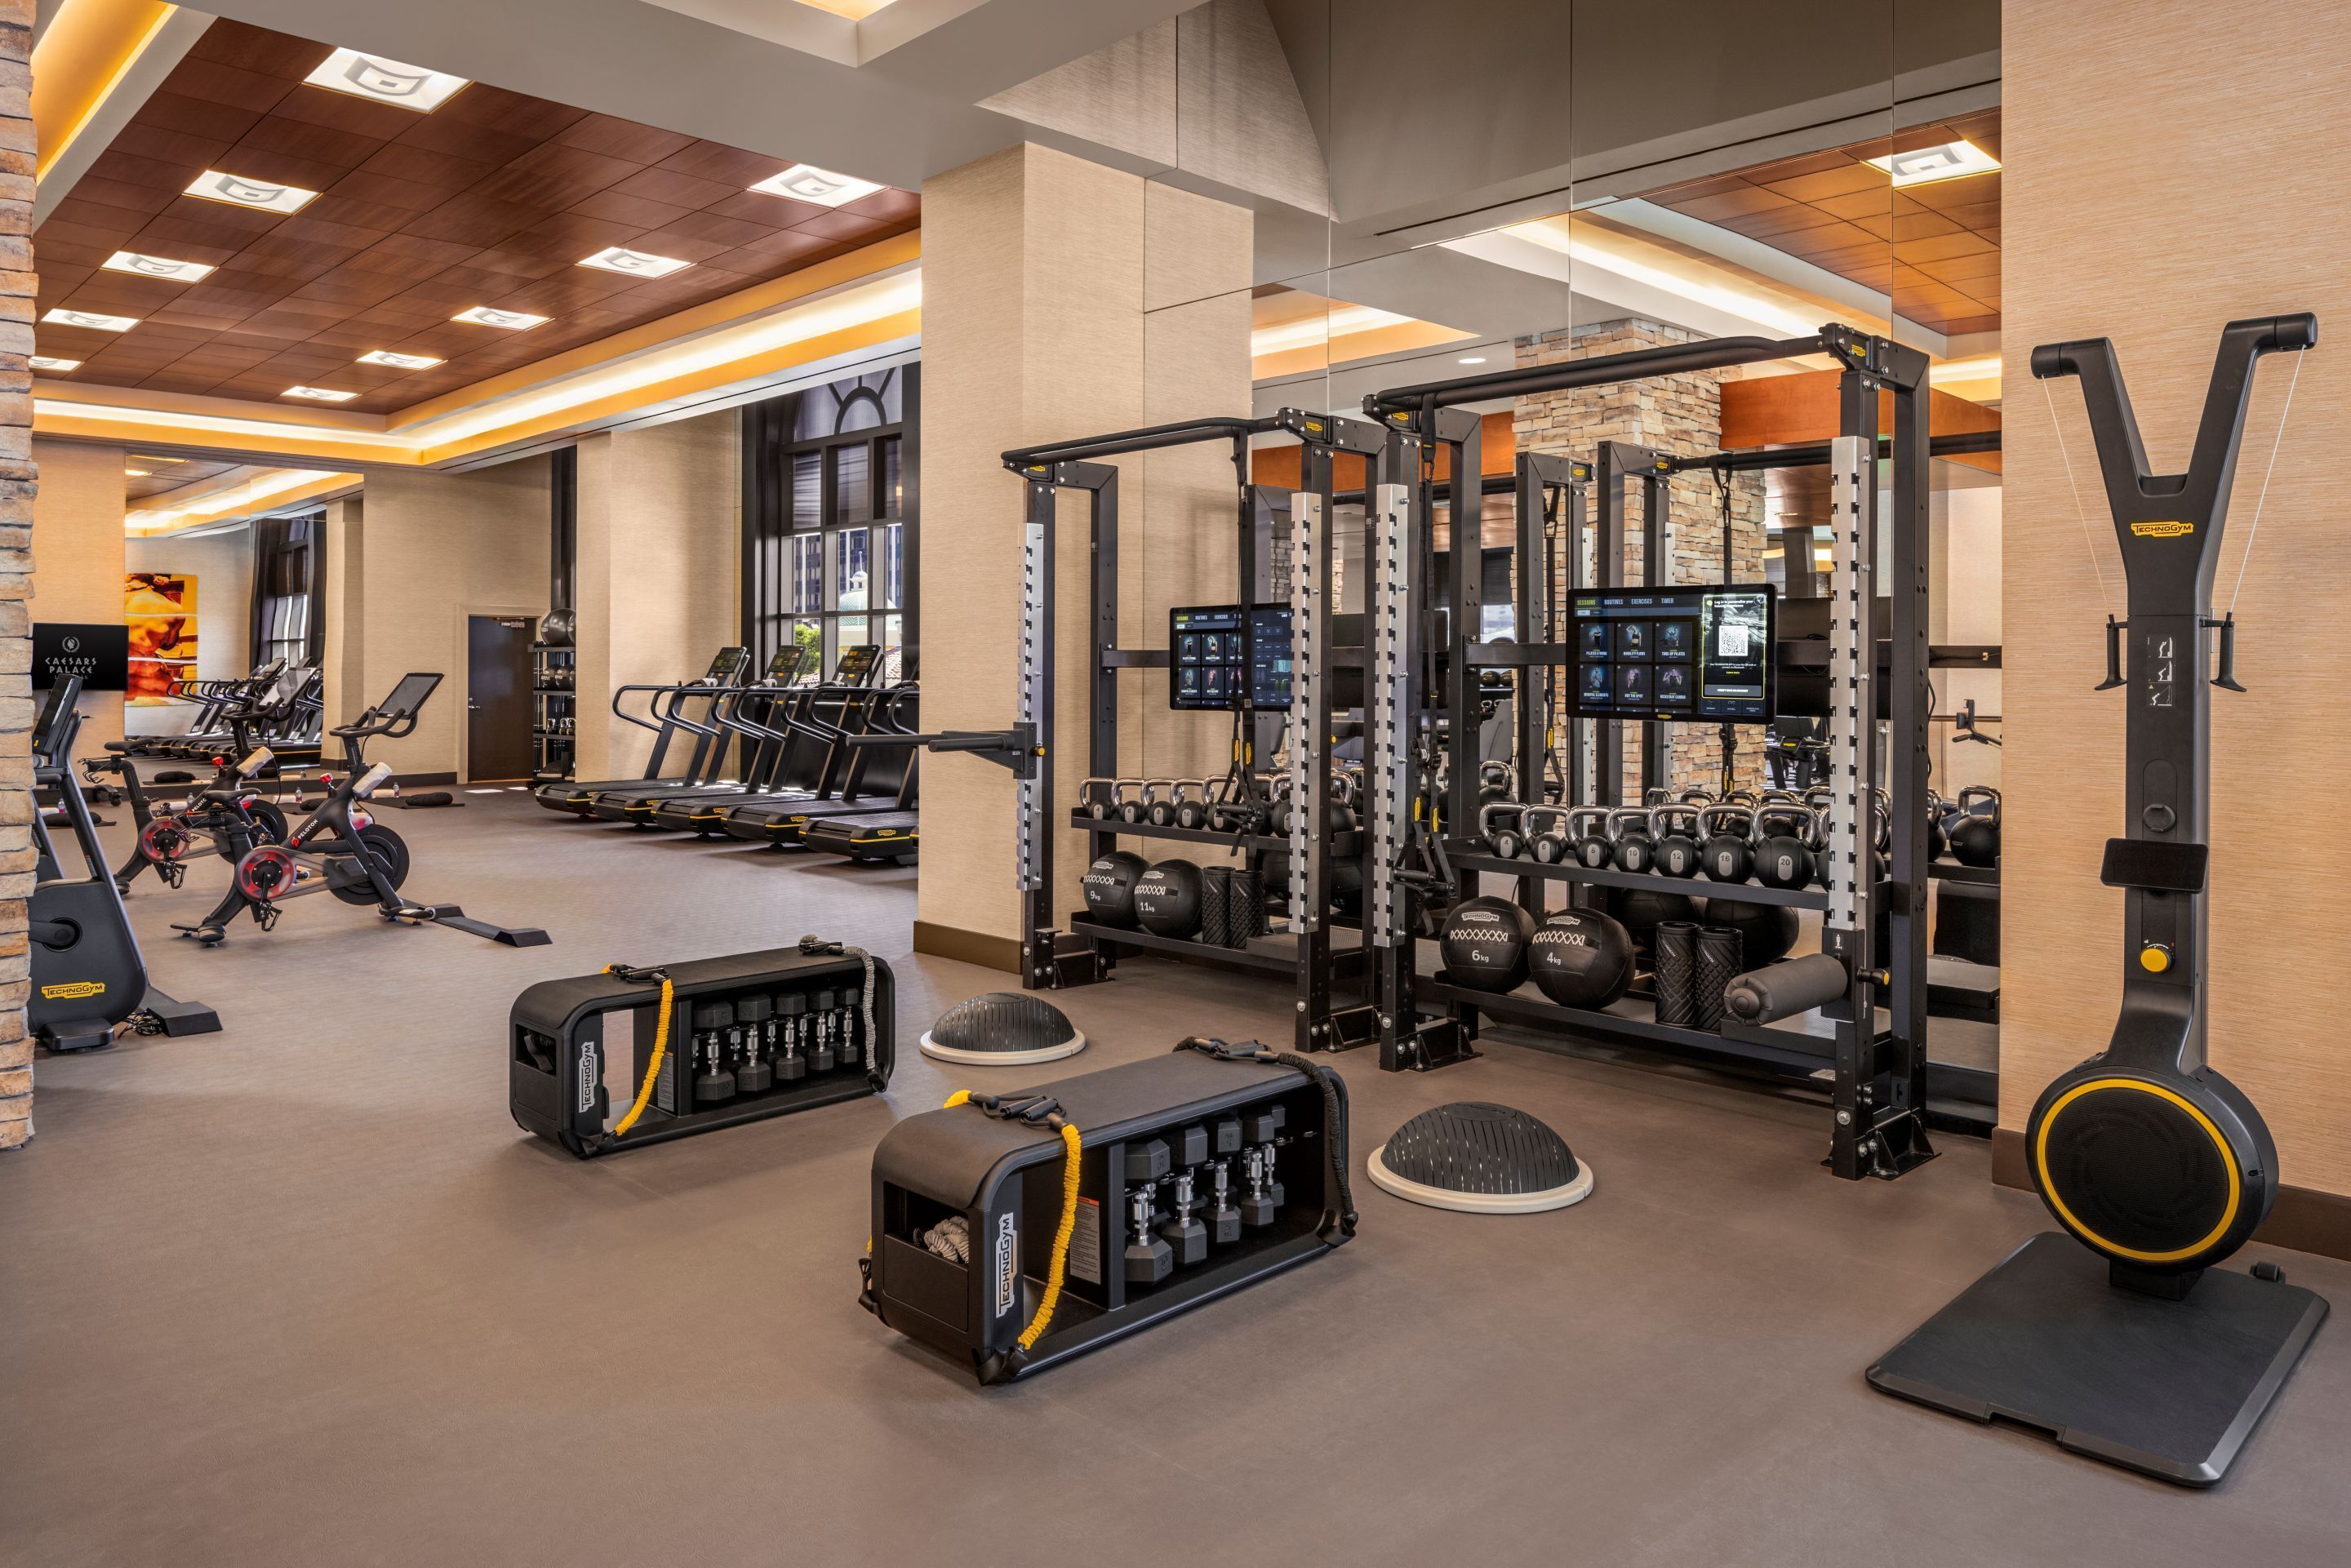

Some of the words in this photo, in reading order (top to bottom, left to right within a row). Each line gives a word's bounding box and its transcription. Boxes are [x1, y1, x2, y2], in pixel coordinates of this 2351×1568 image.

[2132, 522, 2192, 535] TECHNOGYM
[45, 657, 97, 665] CAESARS
[192, 797, 207, 812] PELOTO
[297, 819, 318, 840] PELOTON
[1471, 950, 1490, 962] 6kg
[1547, 953, 1562, 965] 4kg
[43, 984, 103, 997] TECHNOGYM
[581, 1045, 594, 1110] TECHNOGYM
[999, 1218, 1013, 1314] TECHNOGYM
